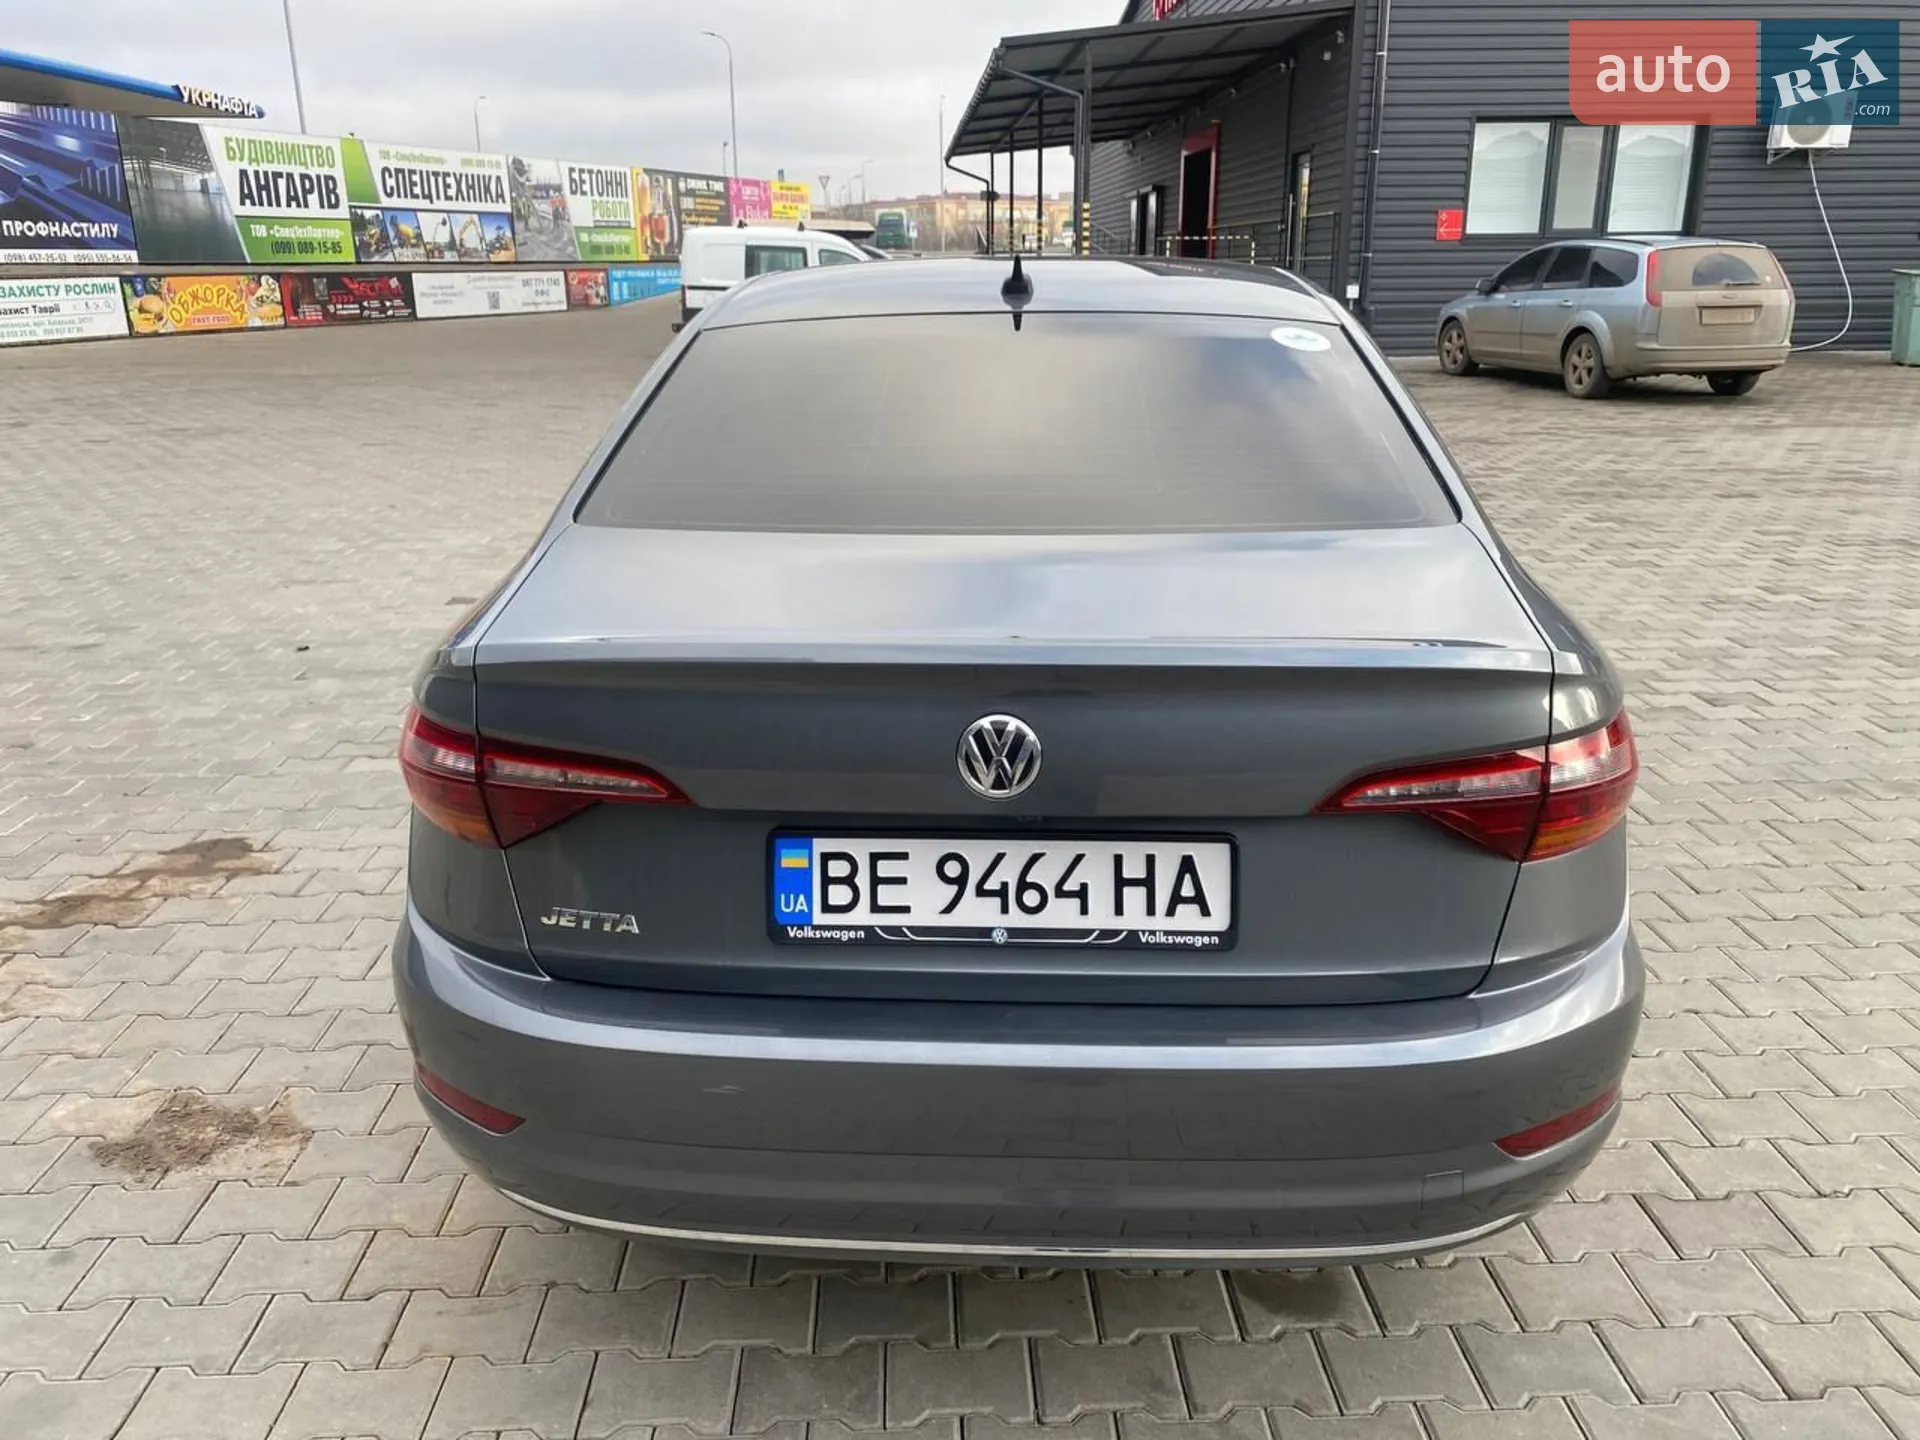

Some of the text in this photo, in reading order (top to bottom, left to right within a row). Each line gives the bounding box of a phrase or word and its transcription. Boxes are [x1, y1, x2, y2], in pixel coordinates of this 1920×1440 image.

[178, 83, 259, 118] УКРНАФТА
[224, 136, 336, 169] БУДІВНИЦТВО
[239, 168, 340, 210] АНГАРІВ
[380, 165, 507, 204] СПЕЦТЕХНІКА
[568, 166, 629, 198] БЕТОННІ
[591, 199, 630, 218] РОБОТИ
[2, 220, 119, 238] ПРОФНАСТИЛУ
[0, 282, 117, 298] ЗАХИСТУ РОСЛИН
[168, 285, 248, 325] ОБЖОРКА
[31, 303, 61, 314] Таврії
[780, 851, 1212, 917] UA BE 9464 HA
[540, 906, 640, 934] JETTA
[787, 925, 865, 942] Volkswagen
[1138, 930, 1220, 947] Volkswagen
